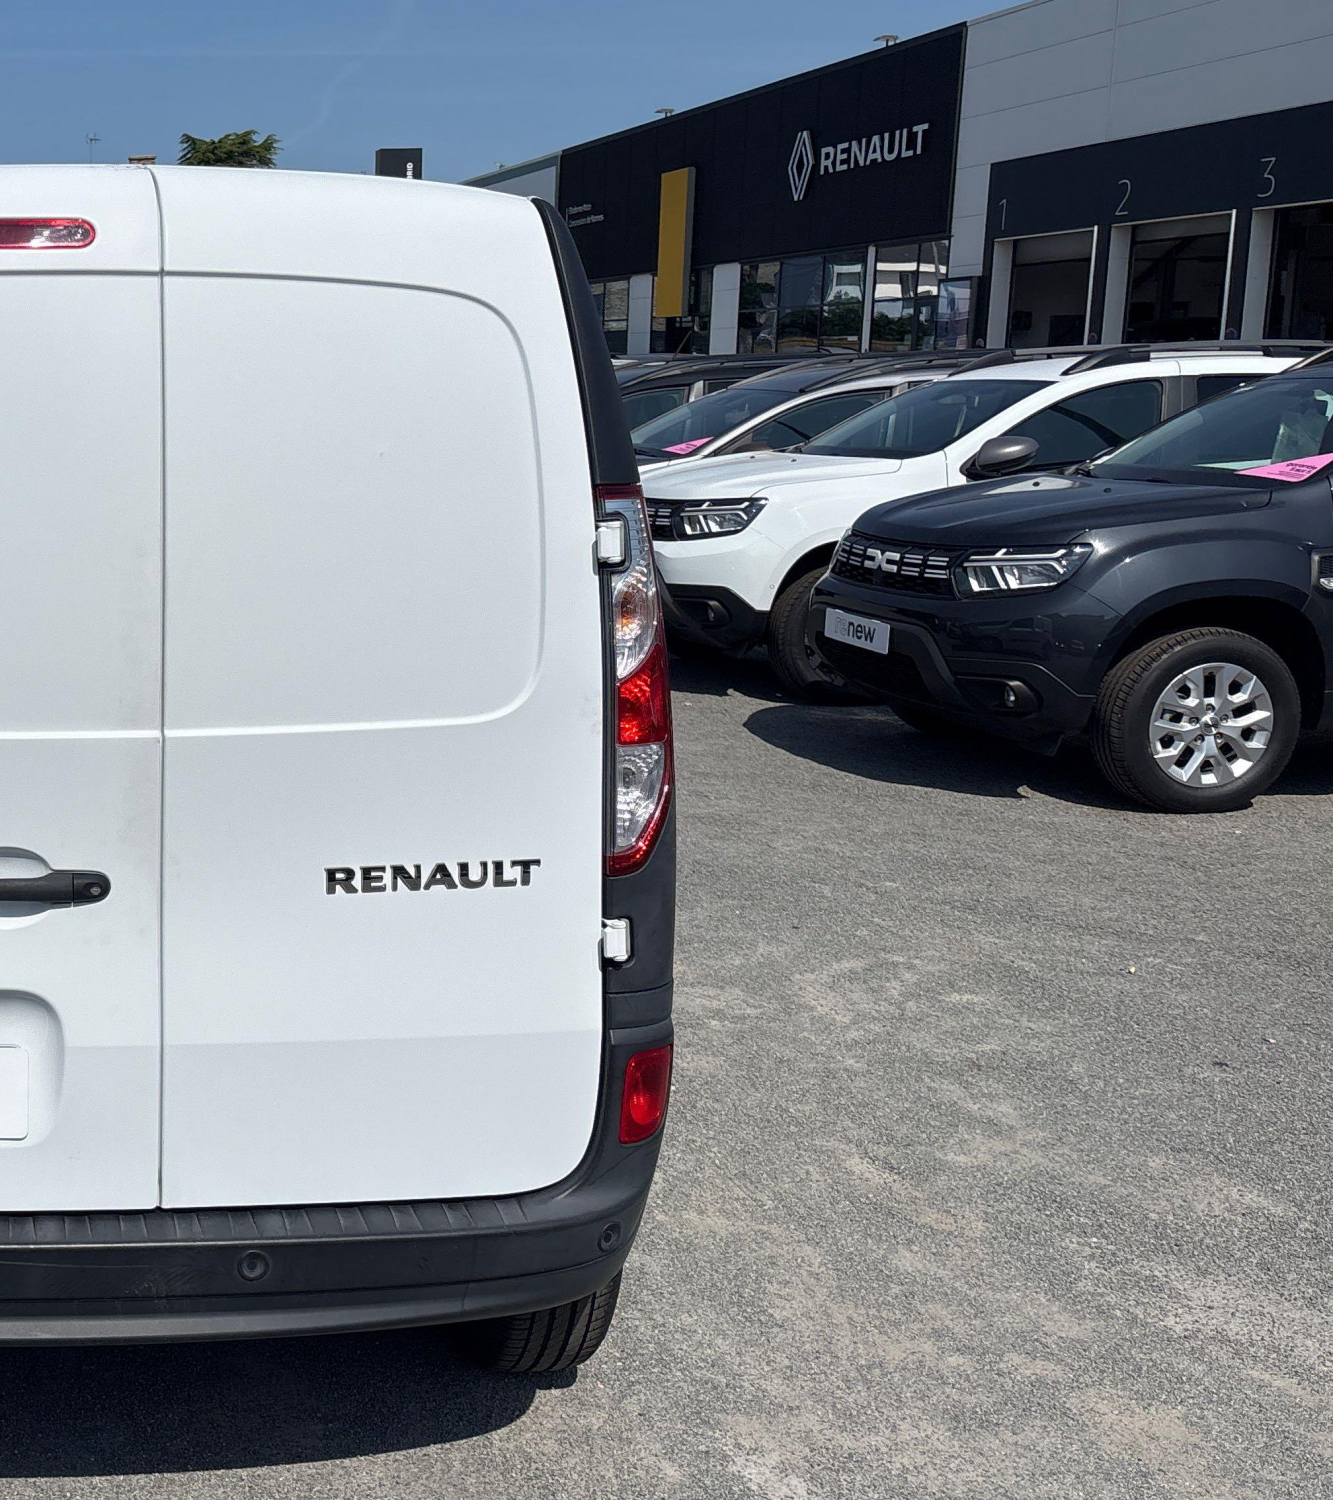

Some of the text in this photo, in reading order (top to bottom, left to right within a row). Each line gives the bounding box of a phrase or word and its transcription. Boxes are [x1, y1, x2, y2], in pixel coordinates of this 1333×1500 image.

[819, 123, 930, 176] RENAULT
[1256, 156, 1277, 198] 3
[998, 198, 1008, 231] 1
[1114, 179, 1132, 216] 2
[834, 616, 876, 644] renew
[323, 858, 542, 895] RENAULT
